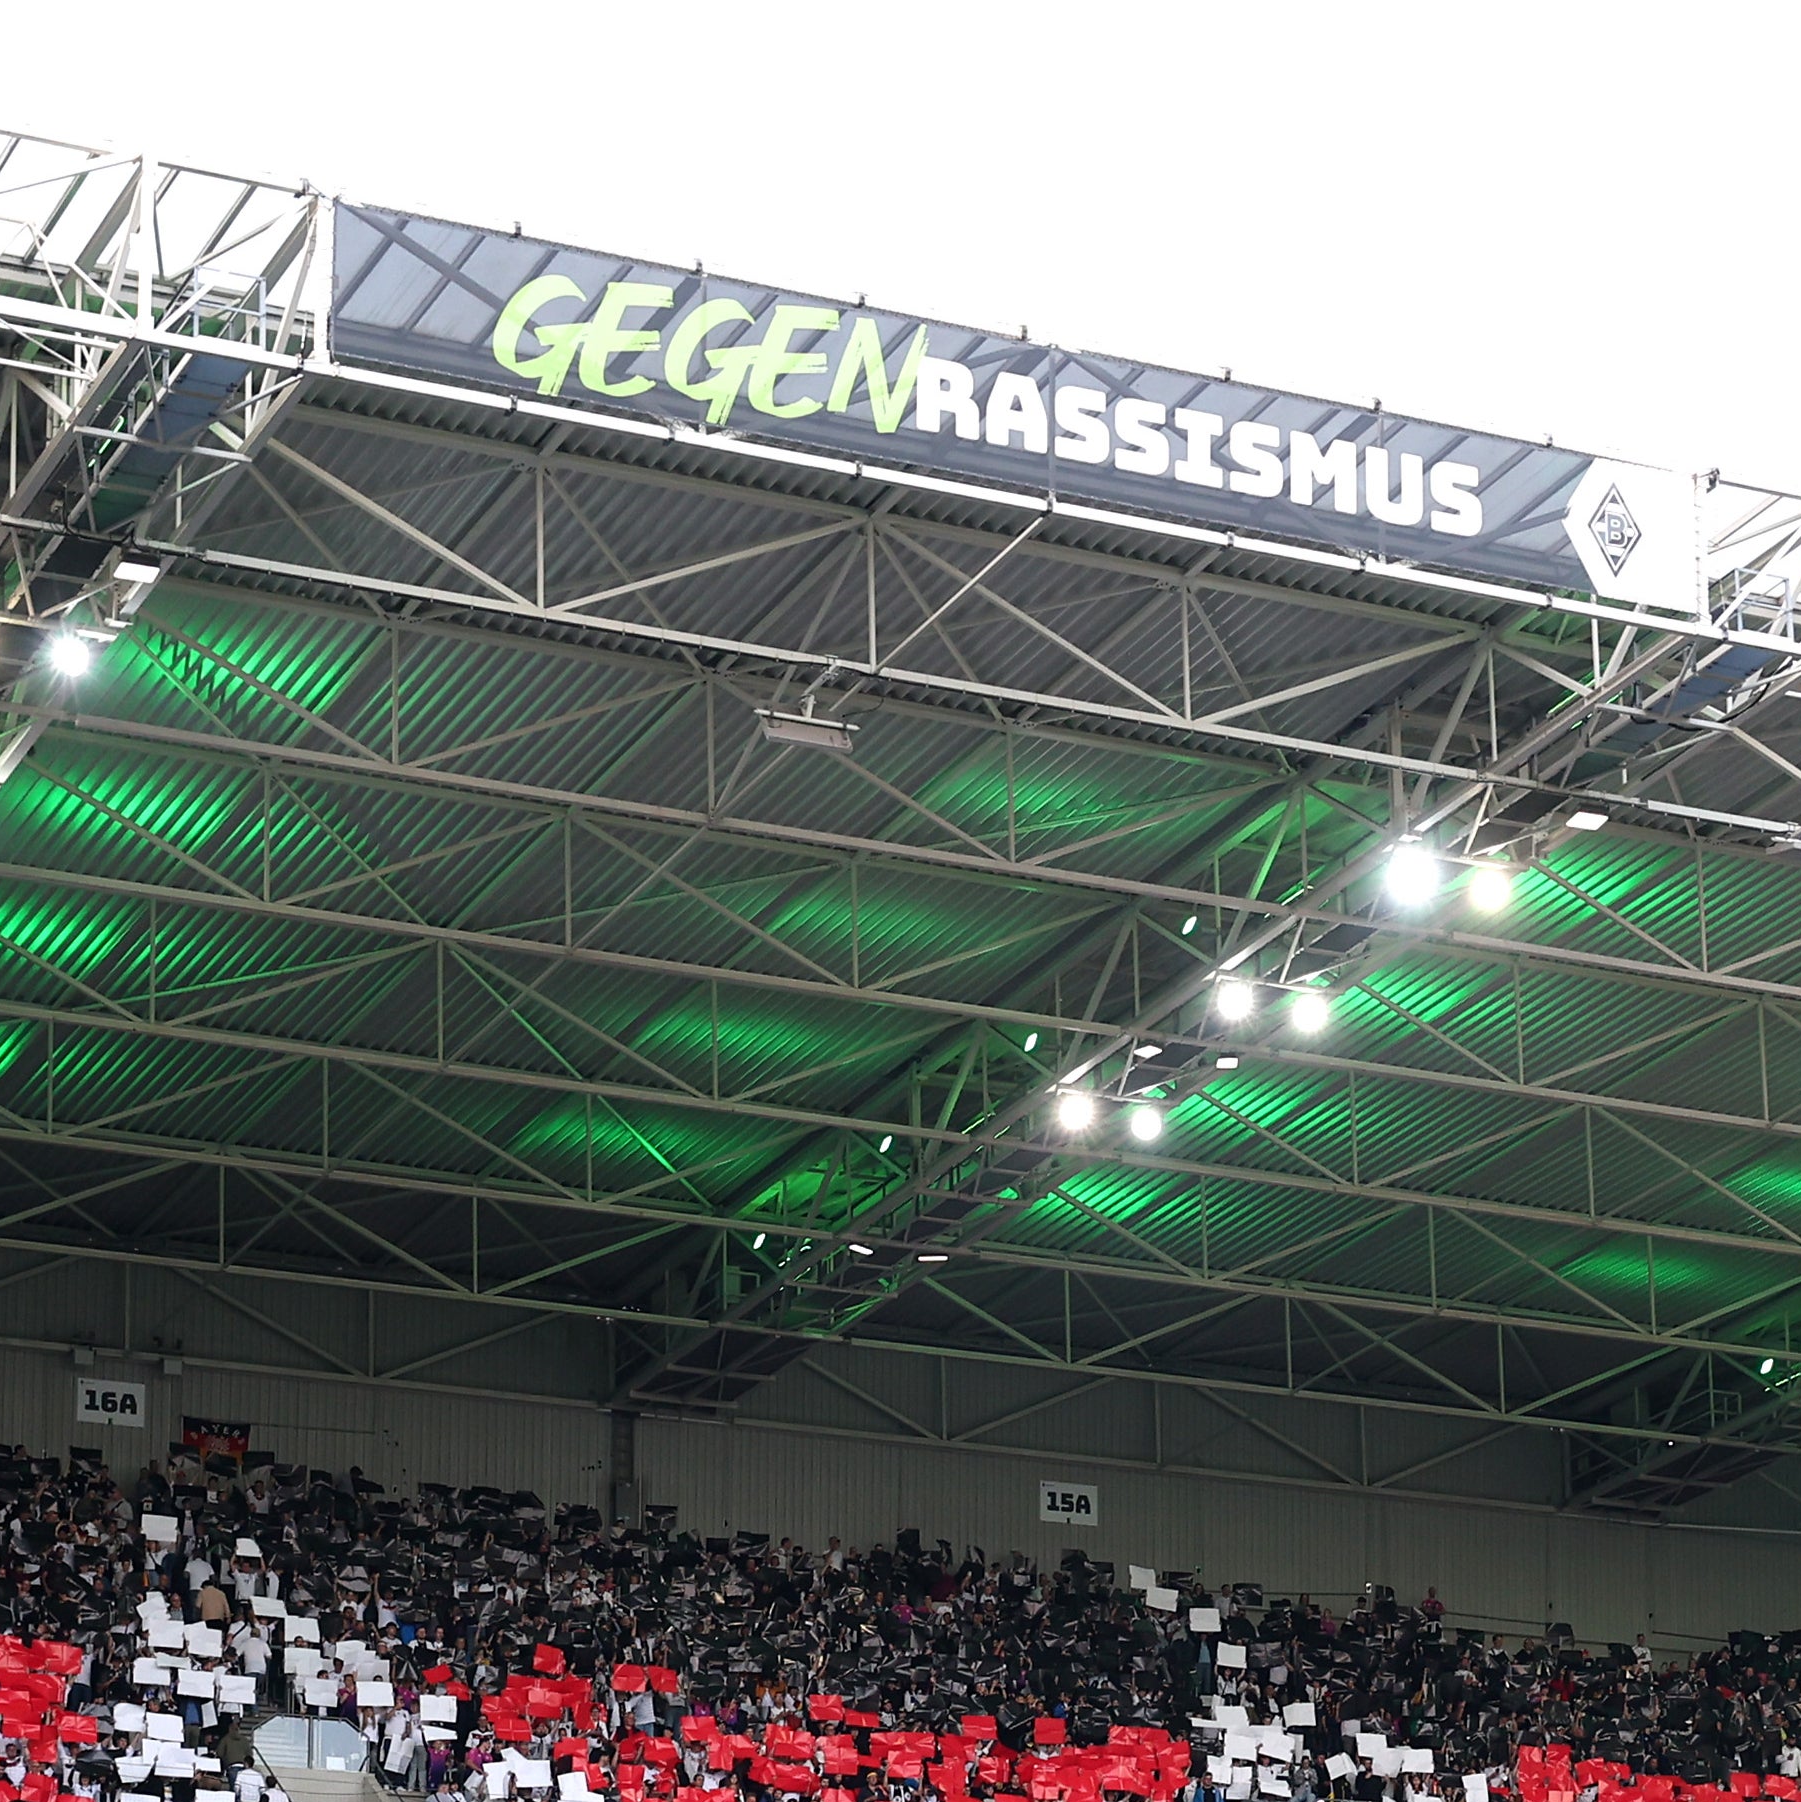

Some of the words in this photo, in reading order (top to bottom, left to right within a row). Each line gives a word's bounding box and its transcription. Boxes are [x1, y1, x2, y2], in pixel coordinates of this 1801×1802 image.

[492, 273, 929, 434] GEGEN
[915, 358, 1485, 538] RASSISMUS
[83, 1389, 139, 1416] 16A
[1045, 1491, 1093, 1516] 15A
